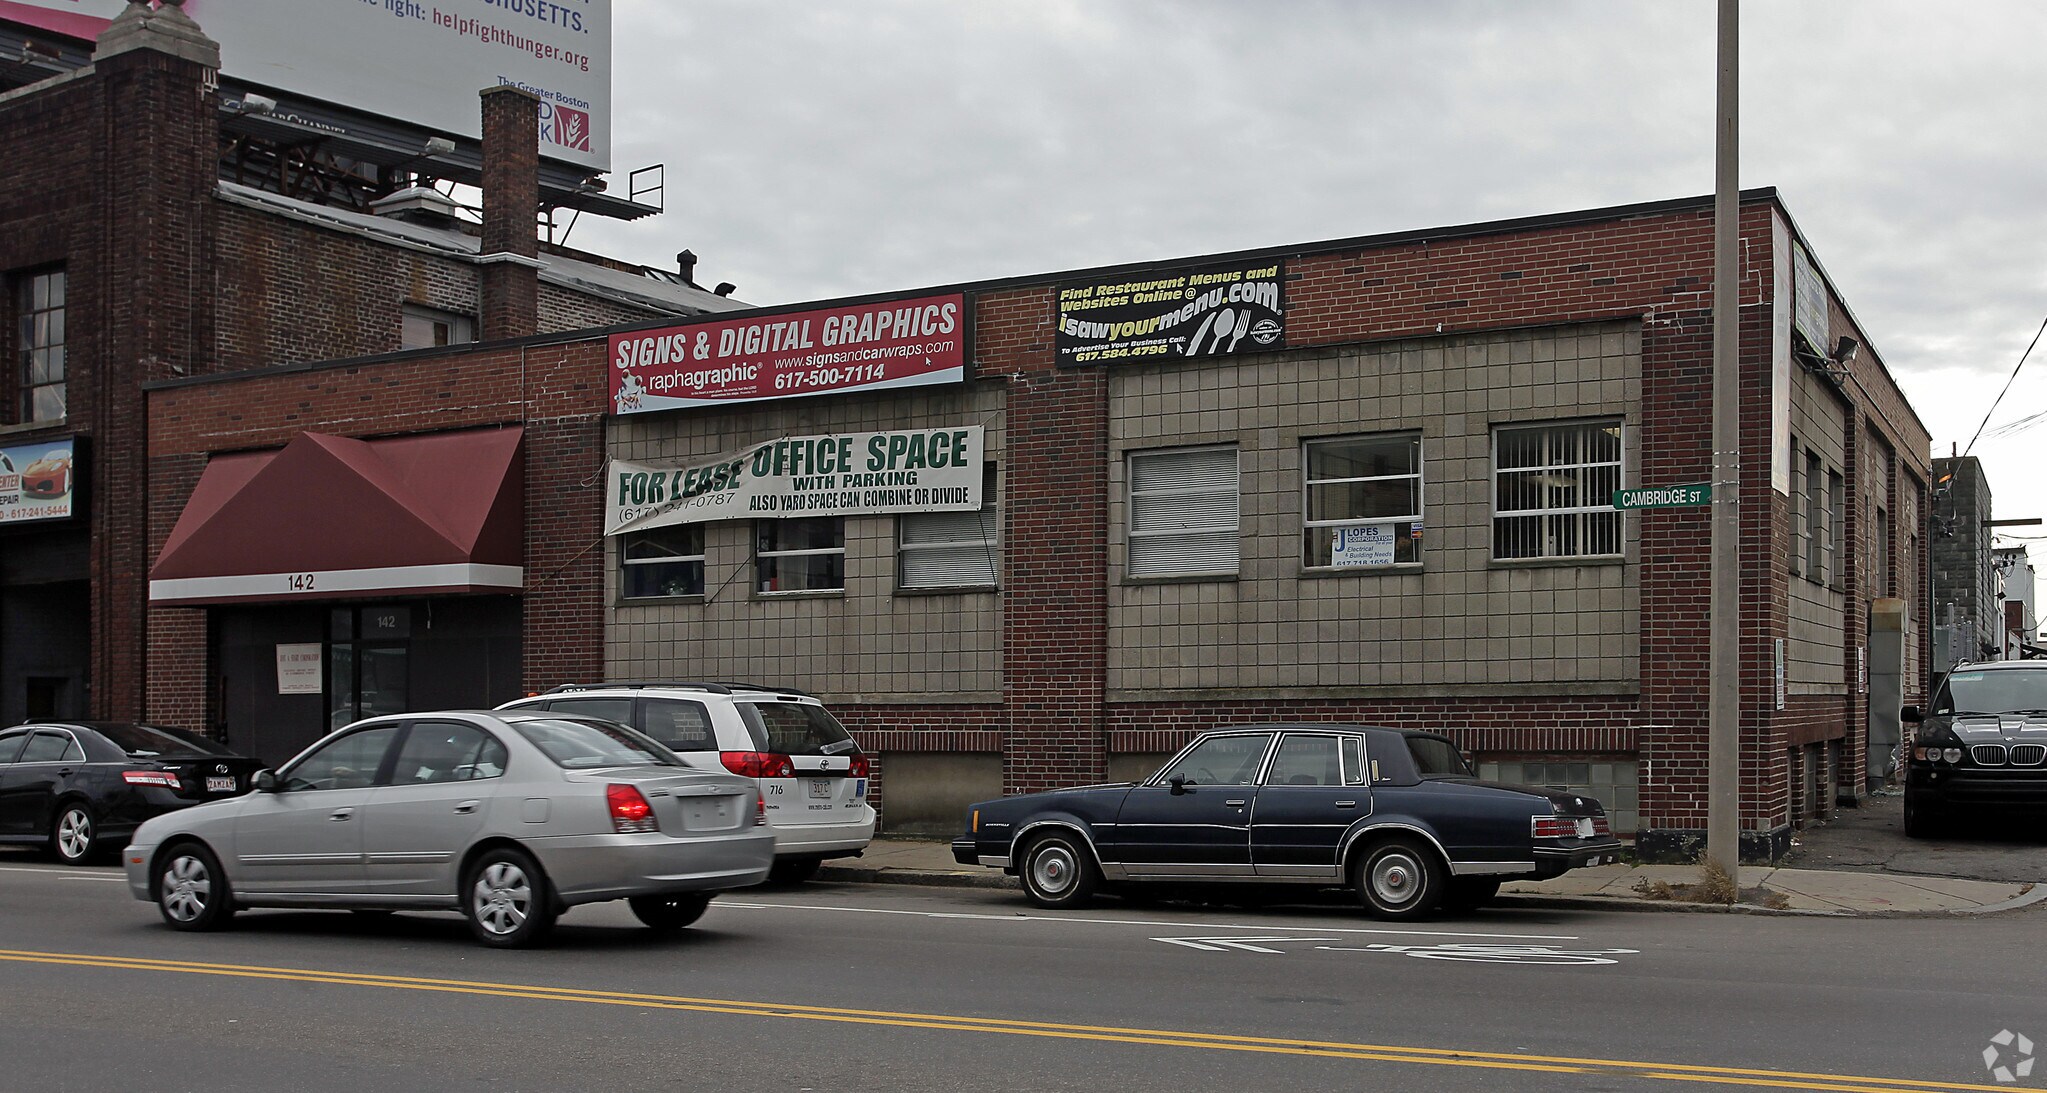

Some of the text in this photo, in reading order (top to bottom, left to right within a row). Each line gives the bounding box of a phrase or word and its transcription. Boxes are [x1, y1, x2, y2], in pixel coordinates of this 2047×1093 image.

[433, 8, 589, 72] helpfighthunger.org
[497, 75, 589, 110] The Greater Boston
[1060, 266, 1278, 300] Find Restaurant Menus and
[1060, 287, 1197, 312] Websites Online @
[615, 302, 957, 369] SIGNS & DIGITAL GRAPHICS
[1071, 343, 1109, 353] Advertise
[1111, 341, 1129, 349] Your
[1131, 338, 1167, 347] Business
[1169, 336, 1187, 344] Call:
[774, 340, 954, 369] www.signsandcarwraps.com
[1075, 344, 1168, 362] 617.584.4796
[774, 363, 885, 390] 617-500-7114
[751, 430, 969, 478] OFFICE SPACE
[618, 458, 745, 506] FOR LEASE
[792, 470, 918, 491] WITH PARKING
[618, 492, 736, 524] (617) 241-0787
[749, 486, 969, 511] ALSO YARD SPACE CAN COMBINE OR DIVIDE
[1622, 489, 1701, 507] CAMBRIDGE ST
[11, 504, 68, 519] 617-241-5444
[1348, 528, 1378, 537] LOPES
[1348, 535, 1393, 543] CORPORATION
[288, 573, 315, 591] 142
[377, 616, 395, 628] 142
[770, 785, 783, 794] 716
